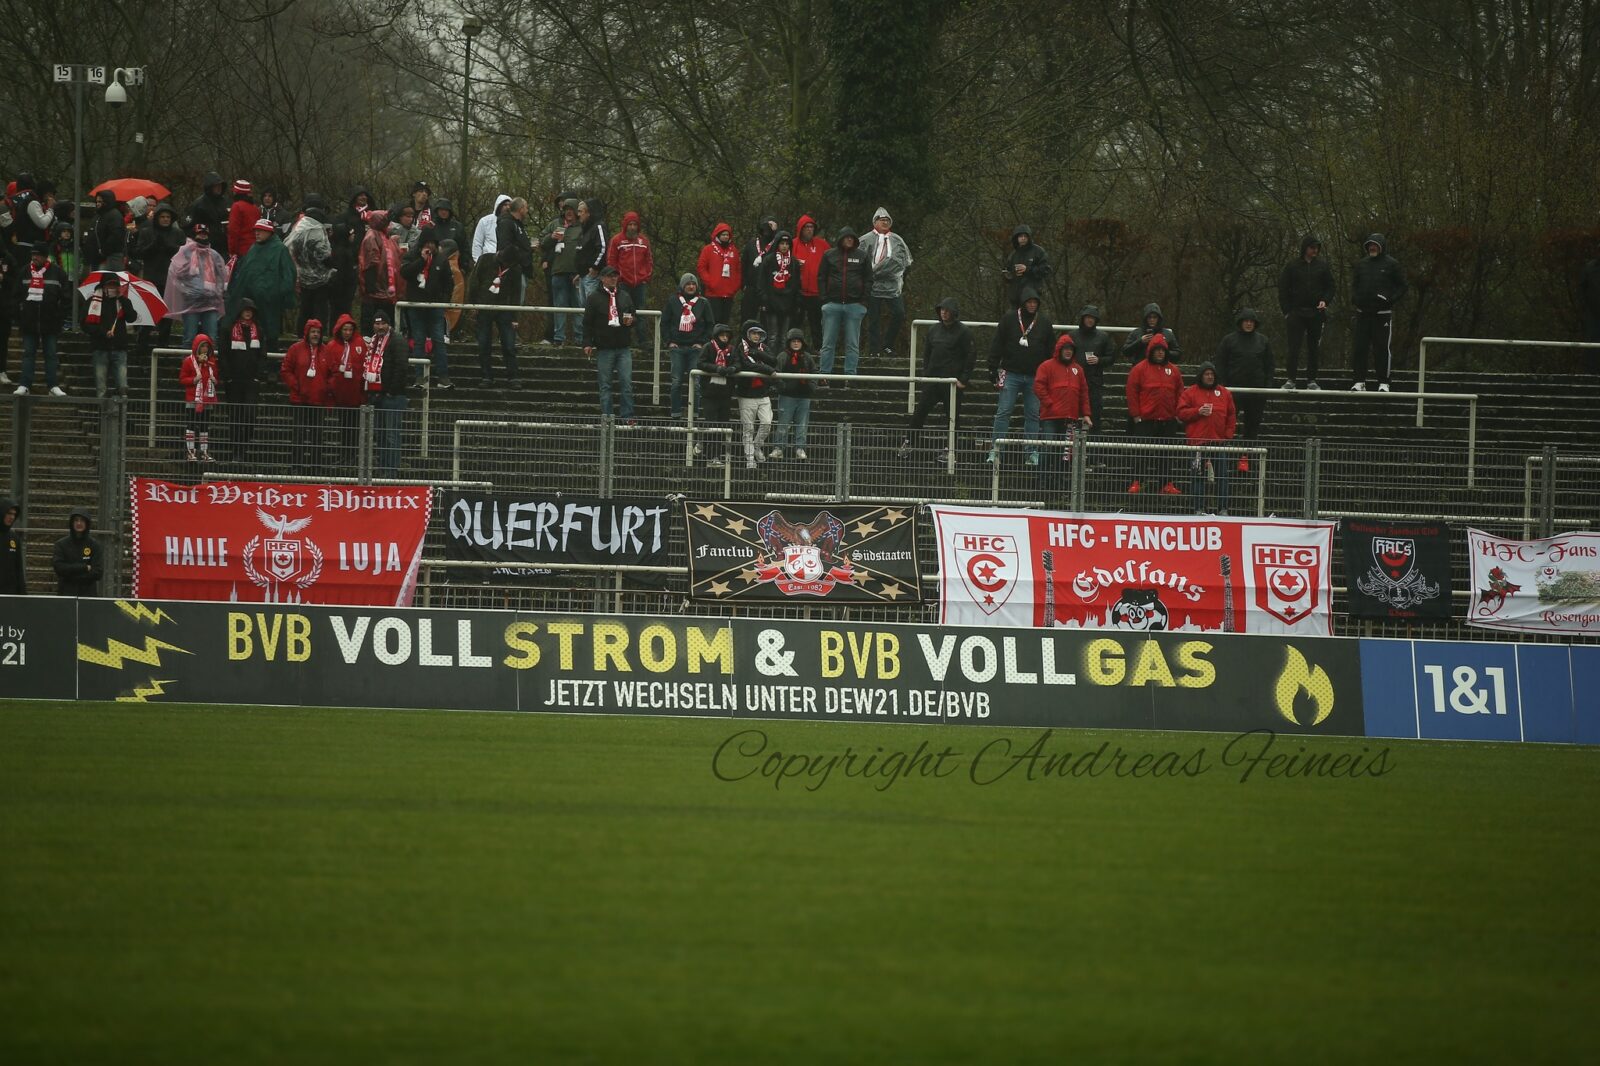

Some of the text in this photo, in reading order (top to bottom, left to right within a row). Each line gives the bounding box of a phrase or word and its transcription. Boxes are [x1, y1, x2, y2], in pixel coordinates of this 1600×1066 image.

[57, 66, 68, 76] 15
[91, 68, 102, 78] 16
[145, 482, 420, 512] Rot Weißer Phönix
[449, 498, 669, 556] QUERFURT
[1047, 521, 1095, 549] HFC
[1115, 524, 1222, 552] FANCLUB
[165, 536, 228, 567] HALLE
[267, 541, 298, 552] HFC
[338, 541, 401, 576] LUJA
[695, 545, 754, 559] Fanclub
[851, 549, 912, 561] Südstaaten
[963, 536, 1005, 552] HFC
[1257, 548, 1315, 566] HFC
[1072, 559, 1205, 604] Edelfans
[8, 625, 25, 641] by
[228, 612, 1217, 689] BVB VOLL STROM & BVB VOLL GAS
[543, 679, 991, 719] JETZT WECHSELN UNTER DEW21.DE/BVB
[1424, 664, 1507, 715] 1&1
